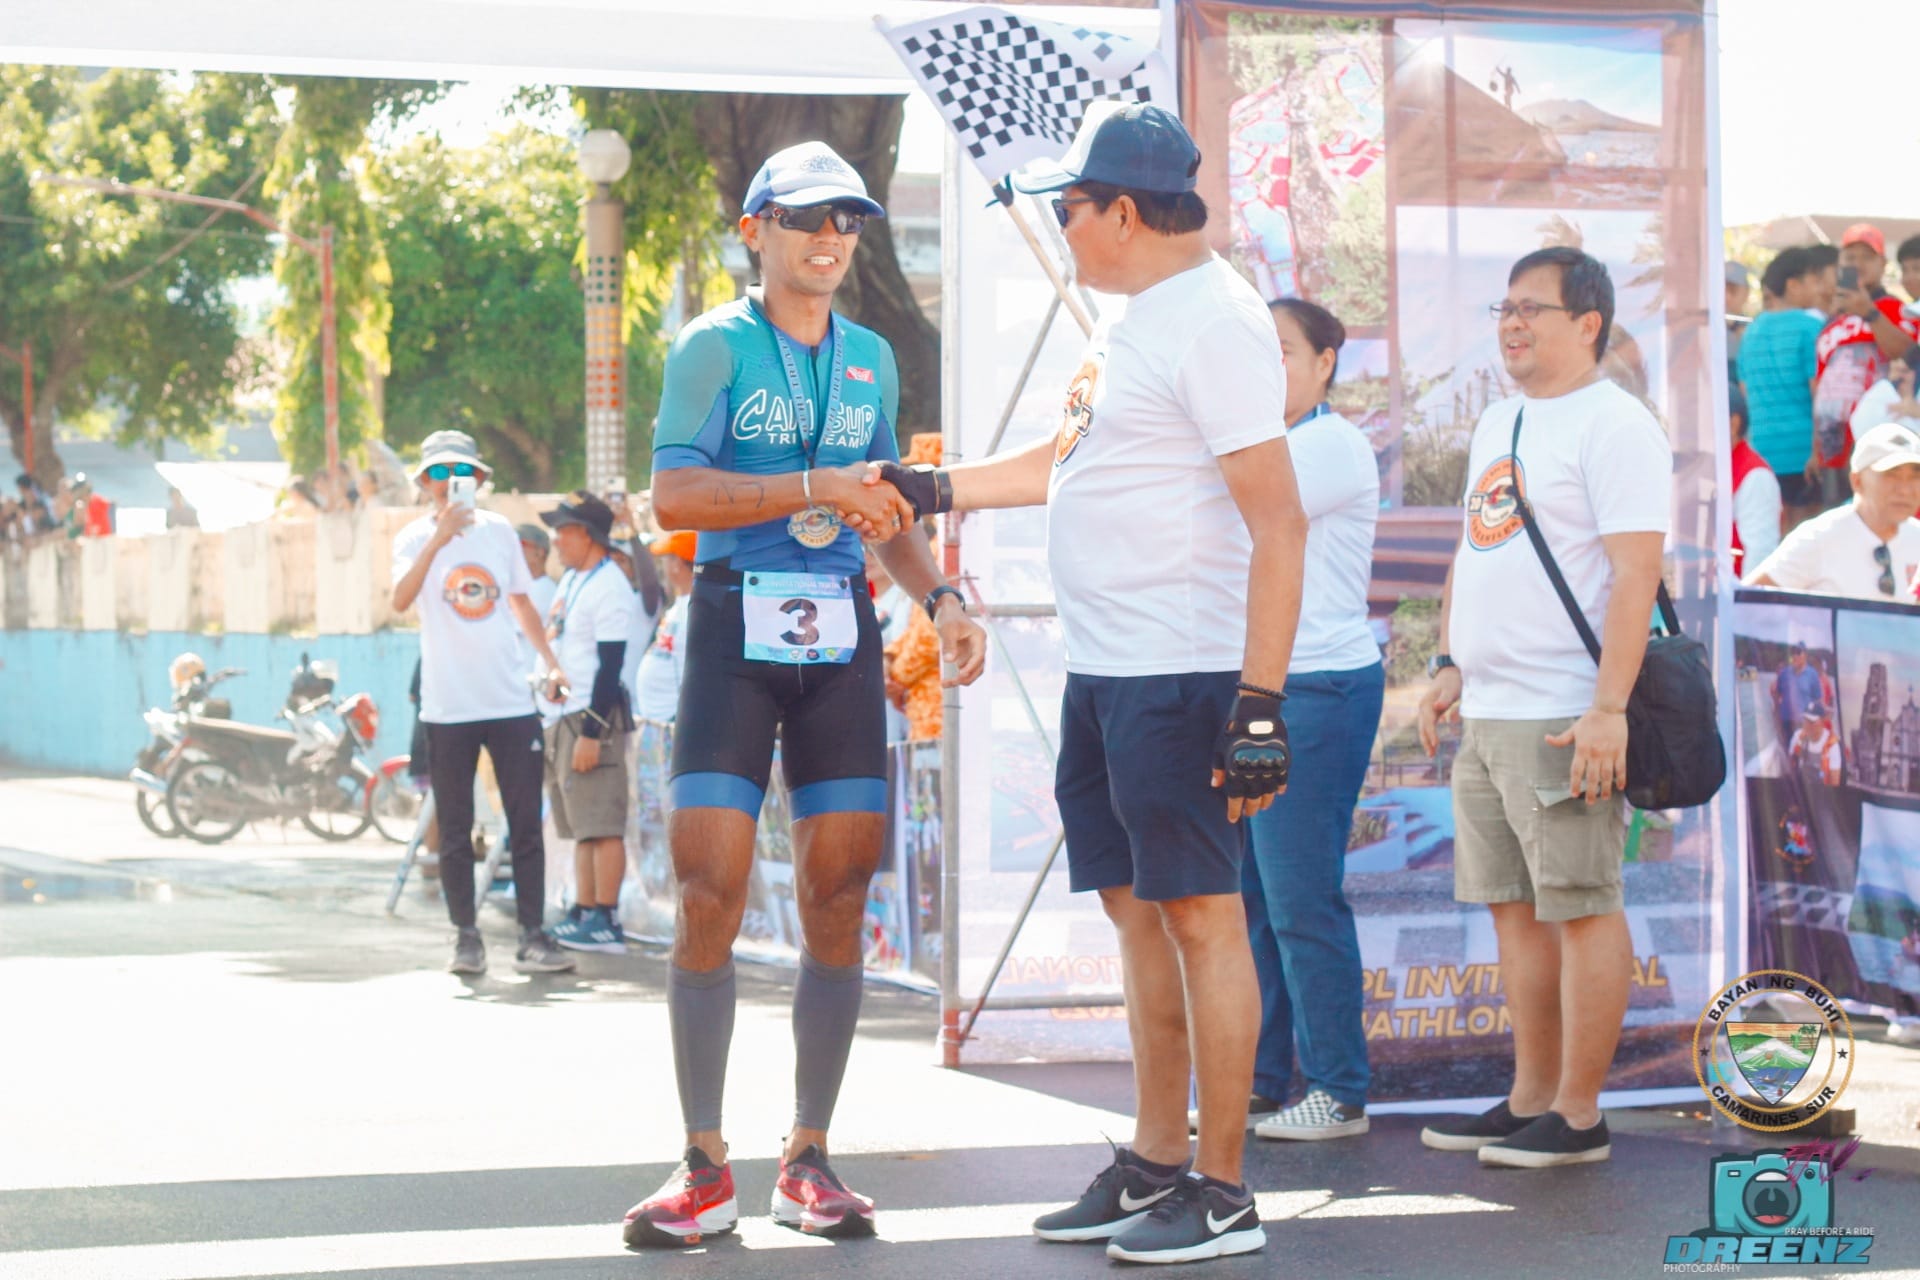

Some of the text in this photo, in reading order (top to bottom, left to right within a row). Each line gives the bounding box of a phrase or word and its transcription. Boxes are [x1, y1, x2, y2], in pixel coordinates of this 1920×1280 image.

[767, 432, 860, 449] TRI EAM
[779, 598, 820, 646] 3
